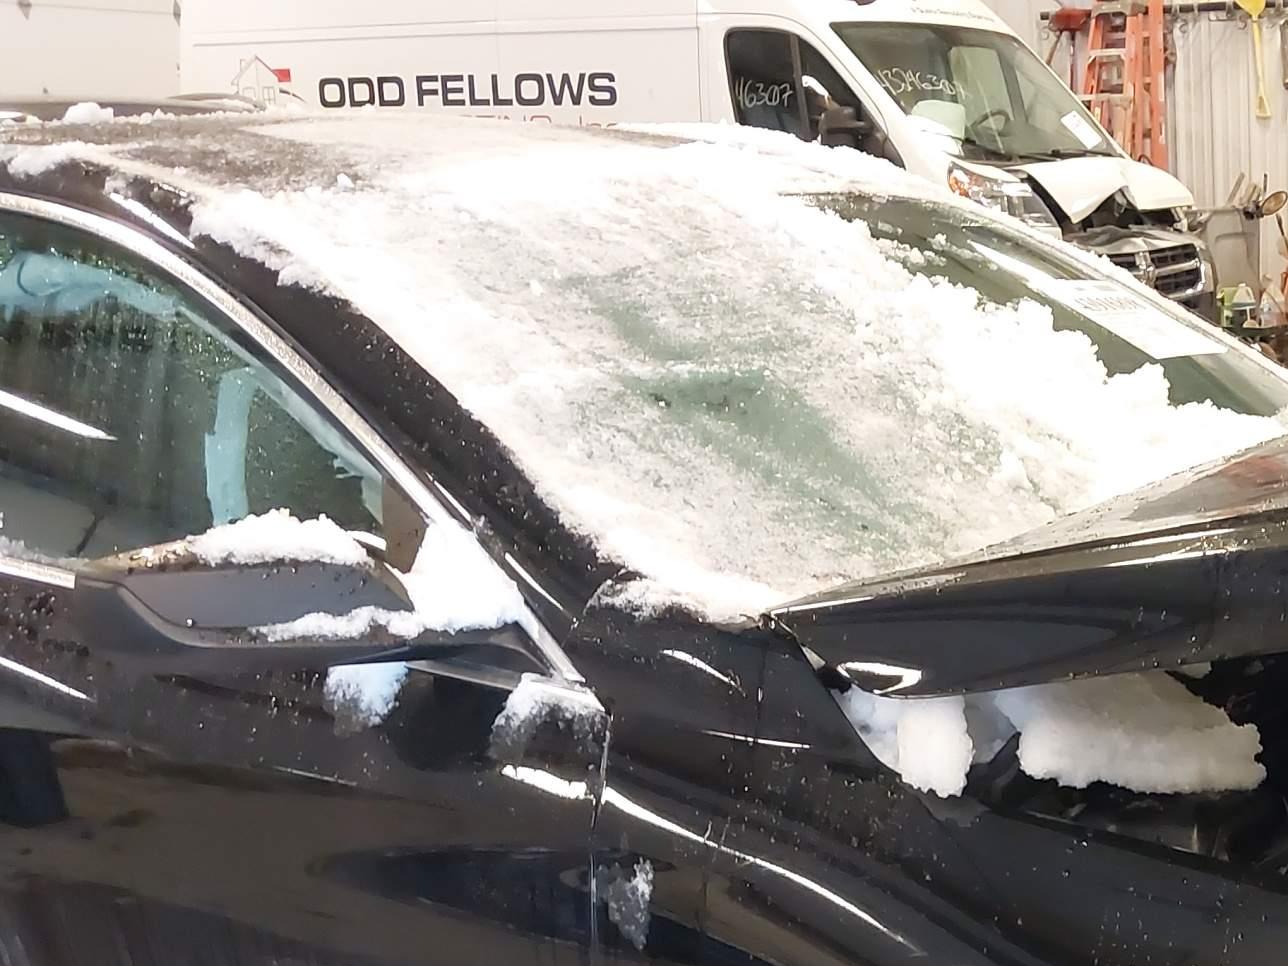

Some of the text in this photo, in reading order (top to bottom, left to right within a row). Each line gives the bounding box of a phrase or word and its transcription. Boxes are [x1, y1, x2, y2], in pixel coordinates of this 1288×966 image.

[318, 72, 618, 108] ODD FELLOWS
[735, 76, 794, 110] 46307
